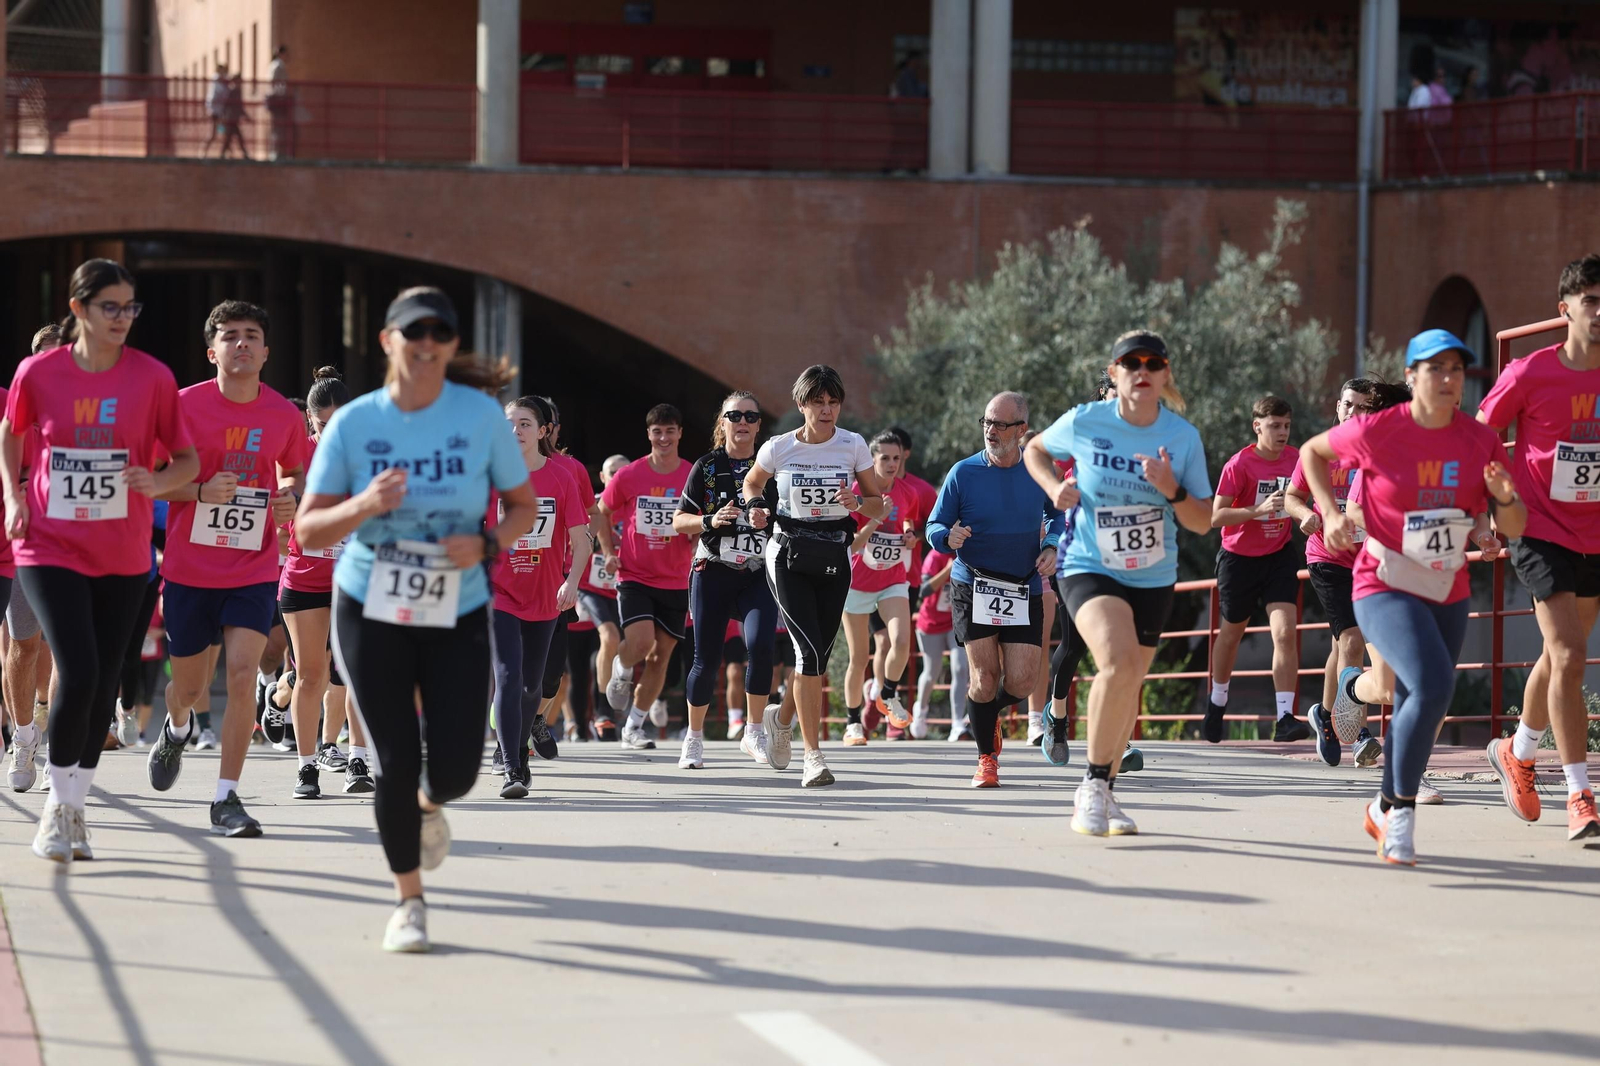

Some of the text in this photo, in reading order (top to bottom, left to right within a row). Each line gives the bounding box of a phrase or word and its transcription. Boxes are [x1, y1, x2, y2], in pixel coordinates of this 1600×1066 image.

[74, 398, 118, 424] WE
[77, 429, 113, 446] RUN
[225, 427, 263, 452] WE
[53, 459, 86, 472] UMA
[226, 454, 255, 470] RUN
[1559, 451, 1591, 462] UMA
[793, 478, 819, 486] UMA
[1417, 460, 1459, 487] WE
[62, 475, 116, 500] 145
[1101, 476, 1158, 496] ATLETISMO
[801, 488, 839, 505] 532
[207, 507, 255, 532] 165
[644, 511, 674, 525] 335
[1099, 516, 1133, 528] UMA
[730, 536, 763, 555] 116
[869, 536, 889, 546] UMA
[1111, 525, 1157, 552] 183
[1426, 527, 1454, 554] 41
[872, 546, 902, 561] 603
[385, 568, 447, 602] 194
[976, 585, 1001, 595] UMA
[988, 597, 1014, 617] 42
